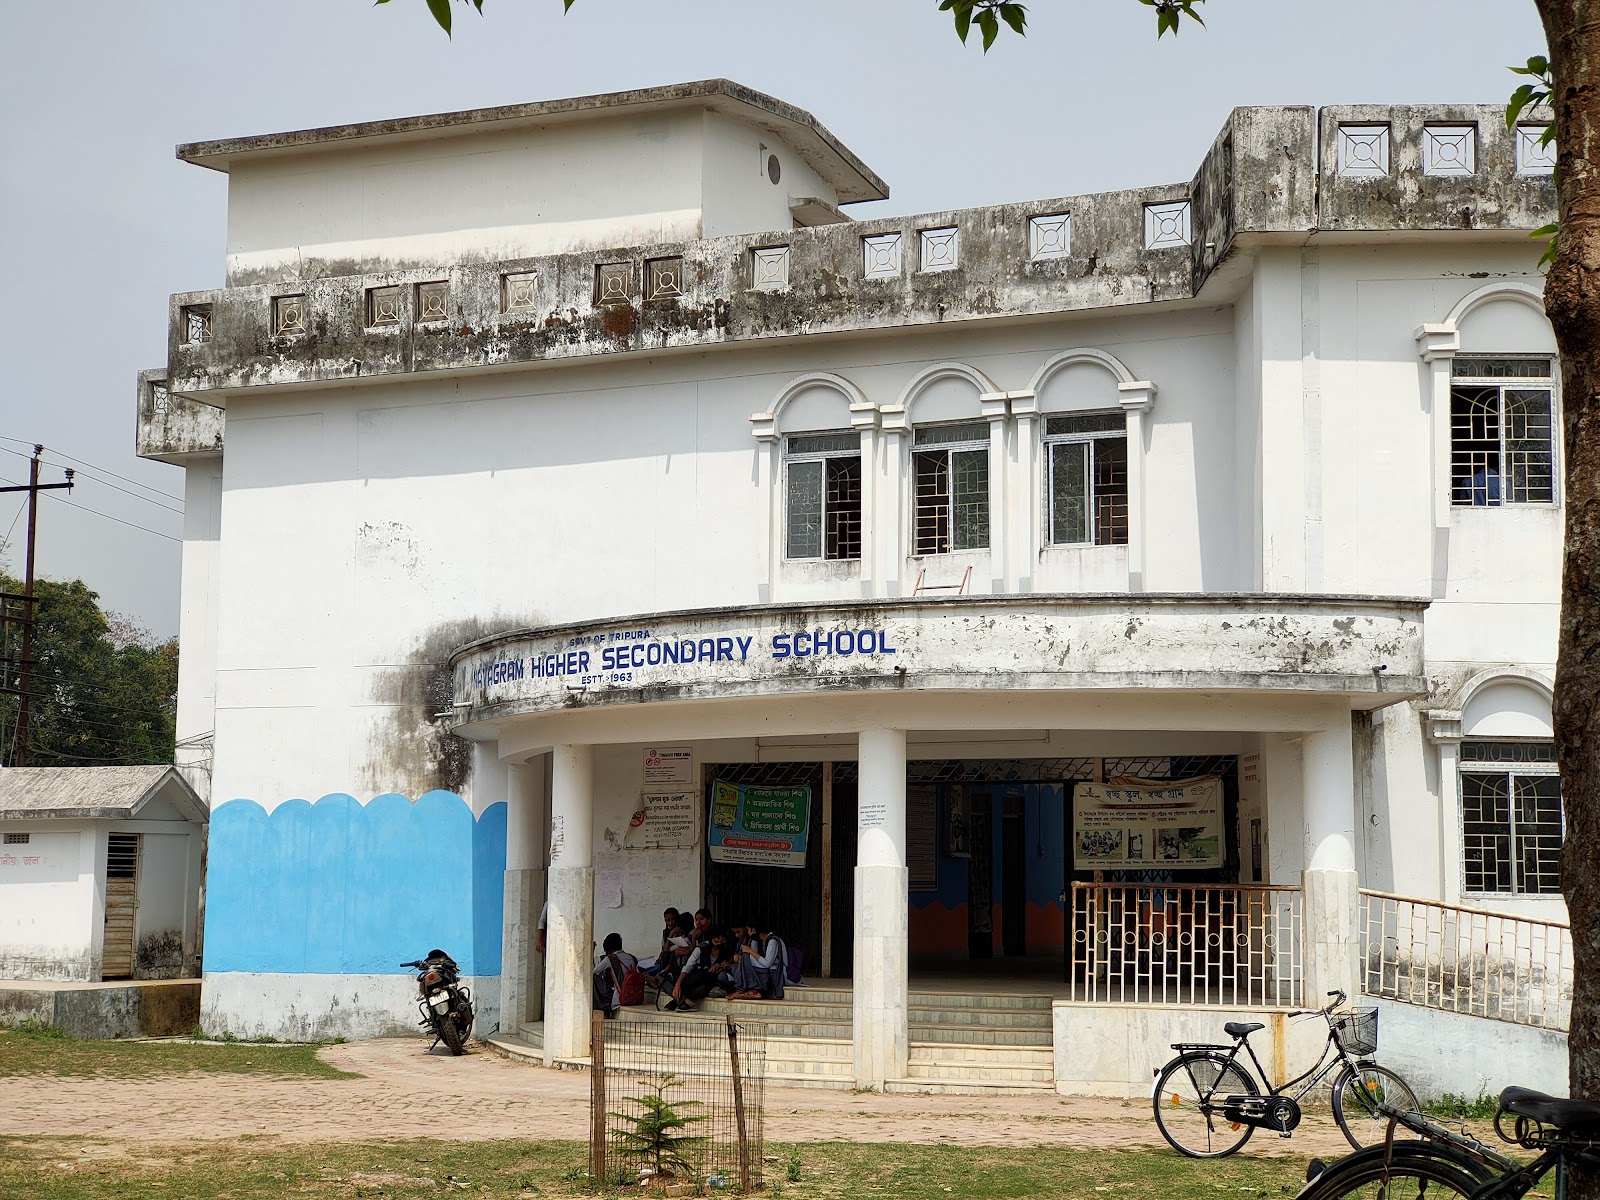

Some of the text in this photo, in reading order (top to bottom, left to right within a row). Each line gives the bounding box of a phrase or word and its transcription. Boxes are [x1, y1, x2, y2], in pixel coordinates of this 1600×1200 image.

[602, 636, 753, 671] SECONDARY
[771, 629, 897, 658] SCHOOL
[22, 856, 41, 866] জল
